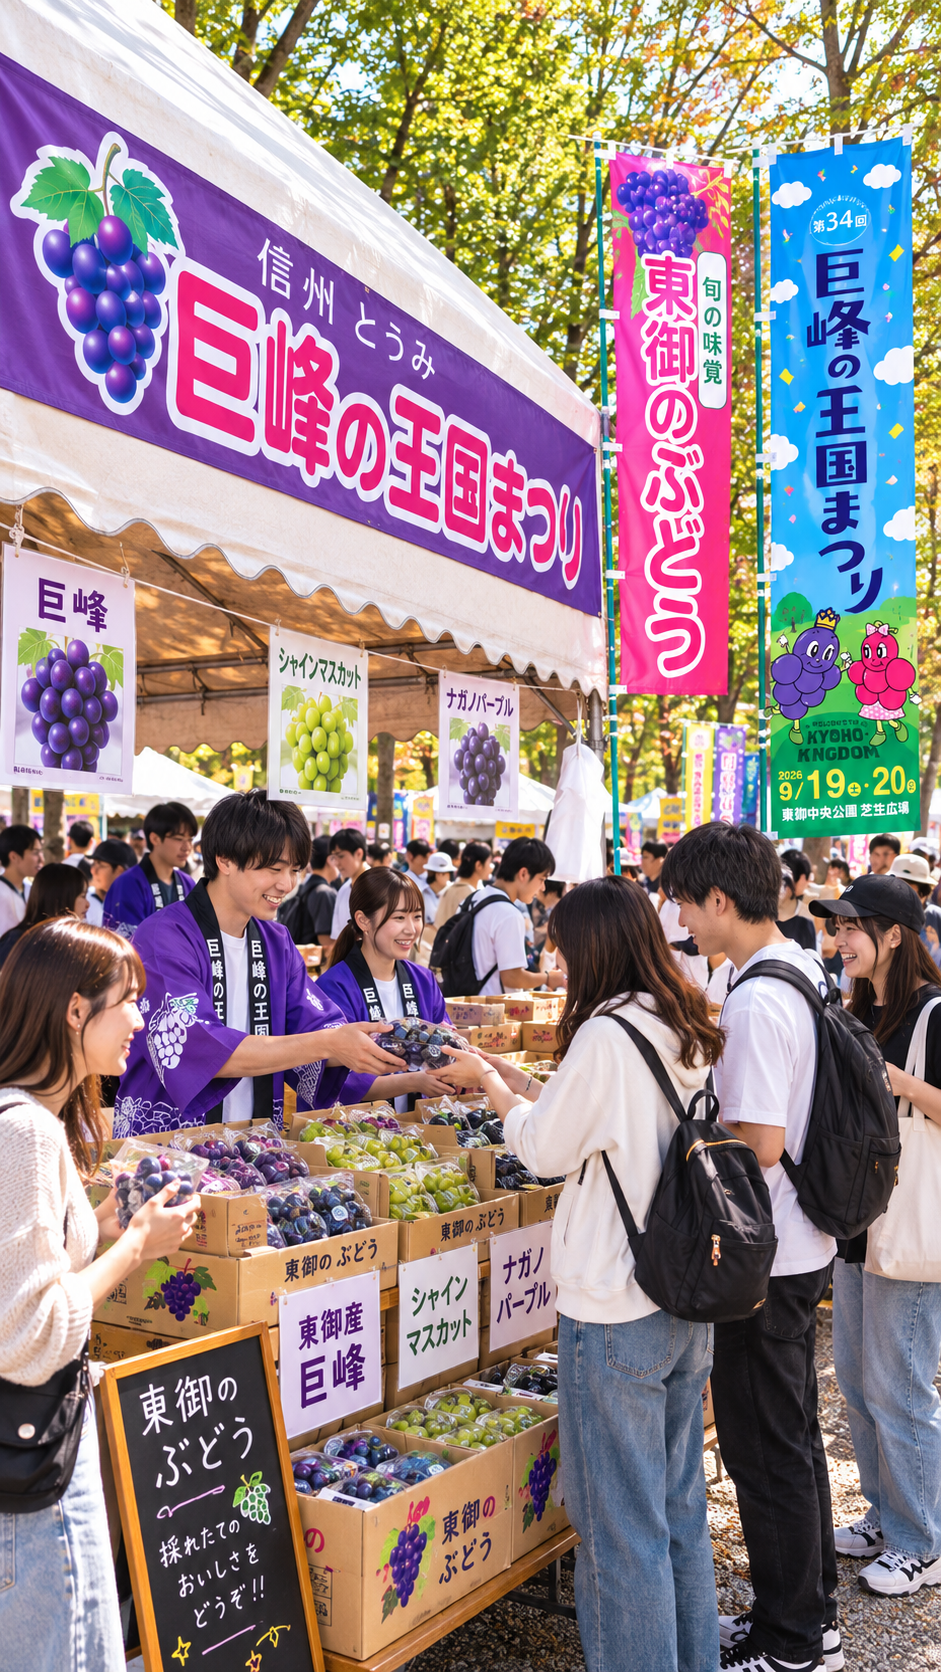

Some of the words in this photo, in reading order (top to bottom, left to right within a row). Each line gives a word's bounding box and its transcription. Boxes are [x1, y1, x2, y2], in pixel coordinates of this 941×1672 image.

[813, 209, 867, 233] 第34回
[257, 238, 335, 325] 信州
[354, 302, 436, 380] とうみ
[702, 277, 723, 386] 旬の味覚
[170, 263, 583, 588] 巨峰の王国まつり
[806, 248, 883, 614] 巨峰の王国まつり
[643, 253, 704, 677] 東御のぶどう
[38, 577, 109, 633] 巨峰
[278, 647, 362, 690] シャインマスカット
[446, 688, 514, 718] ナガノパープル
[778, 770, 803, 780] 2026
[284, 1238, 378, 1283] 東御のぶどう
[502, 1247, 544, 1285] ナガノ
[411, 1275, 468, 1317] シャイン
[496, 1281, 551, 1324] パープル
[298, 1301, 364, 1351] 東御産
[406, 1309, 472, 1356] マスカット
[301, 1343, 366, 1409] 巨峰
[139, 1375, 238, 1436] 東御の
[155, 1416, 253, 1488] ぶどう
[159, 1519, 240, 1568] 採れたての
[304, 1527, 325, 1553] の
[441, 1496, 496, 1545] 東御の
[178, 1542, 259, 1598] おいしさを
[438, 1532, 492, 1585] ぶどう
[194, 1575, 265, 1628] どうぞ!!
